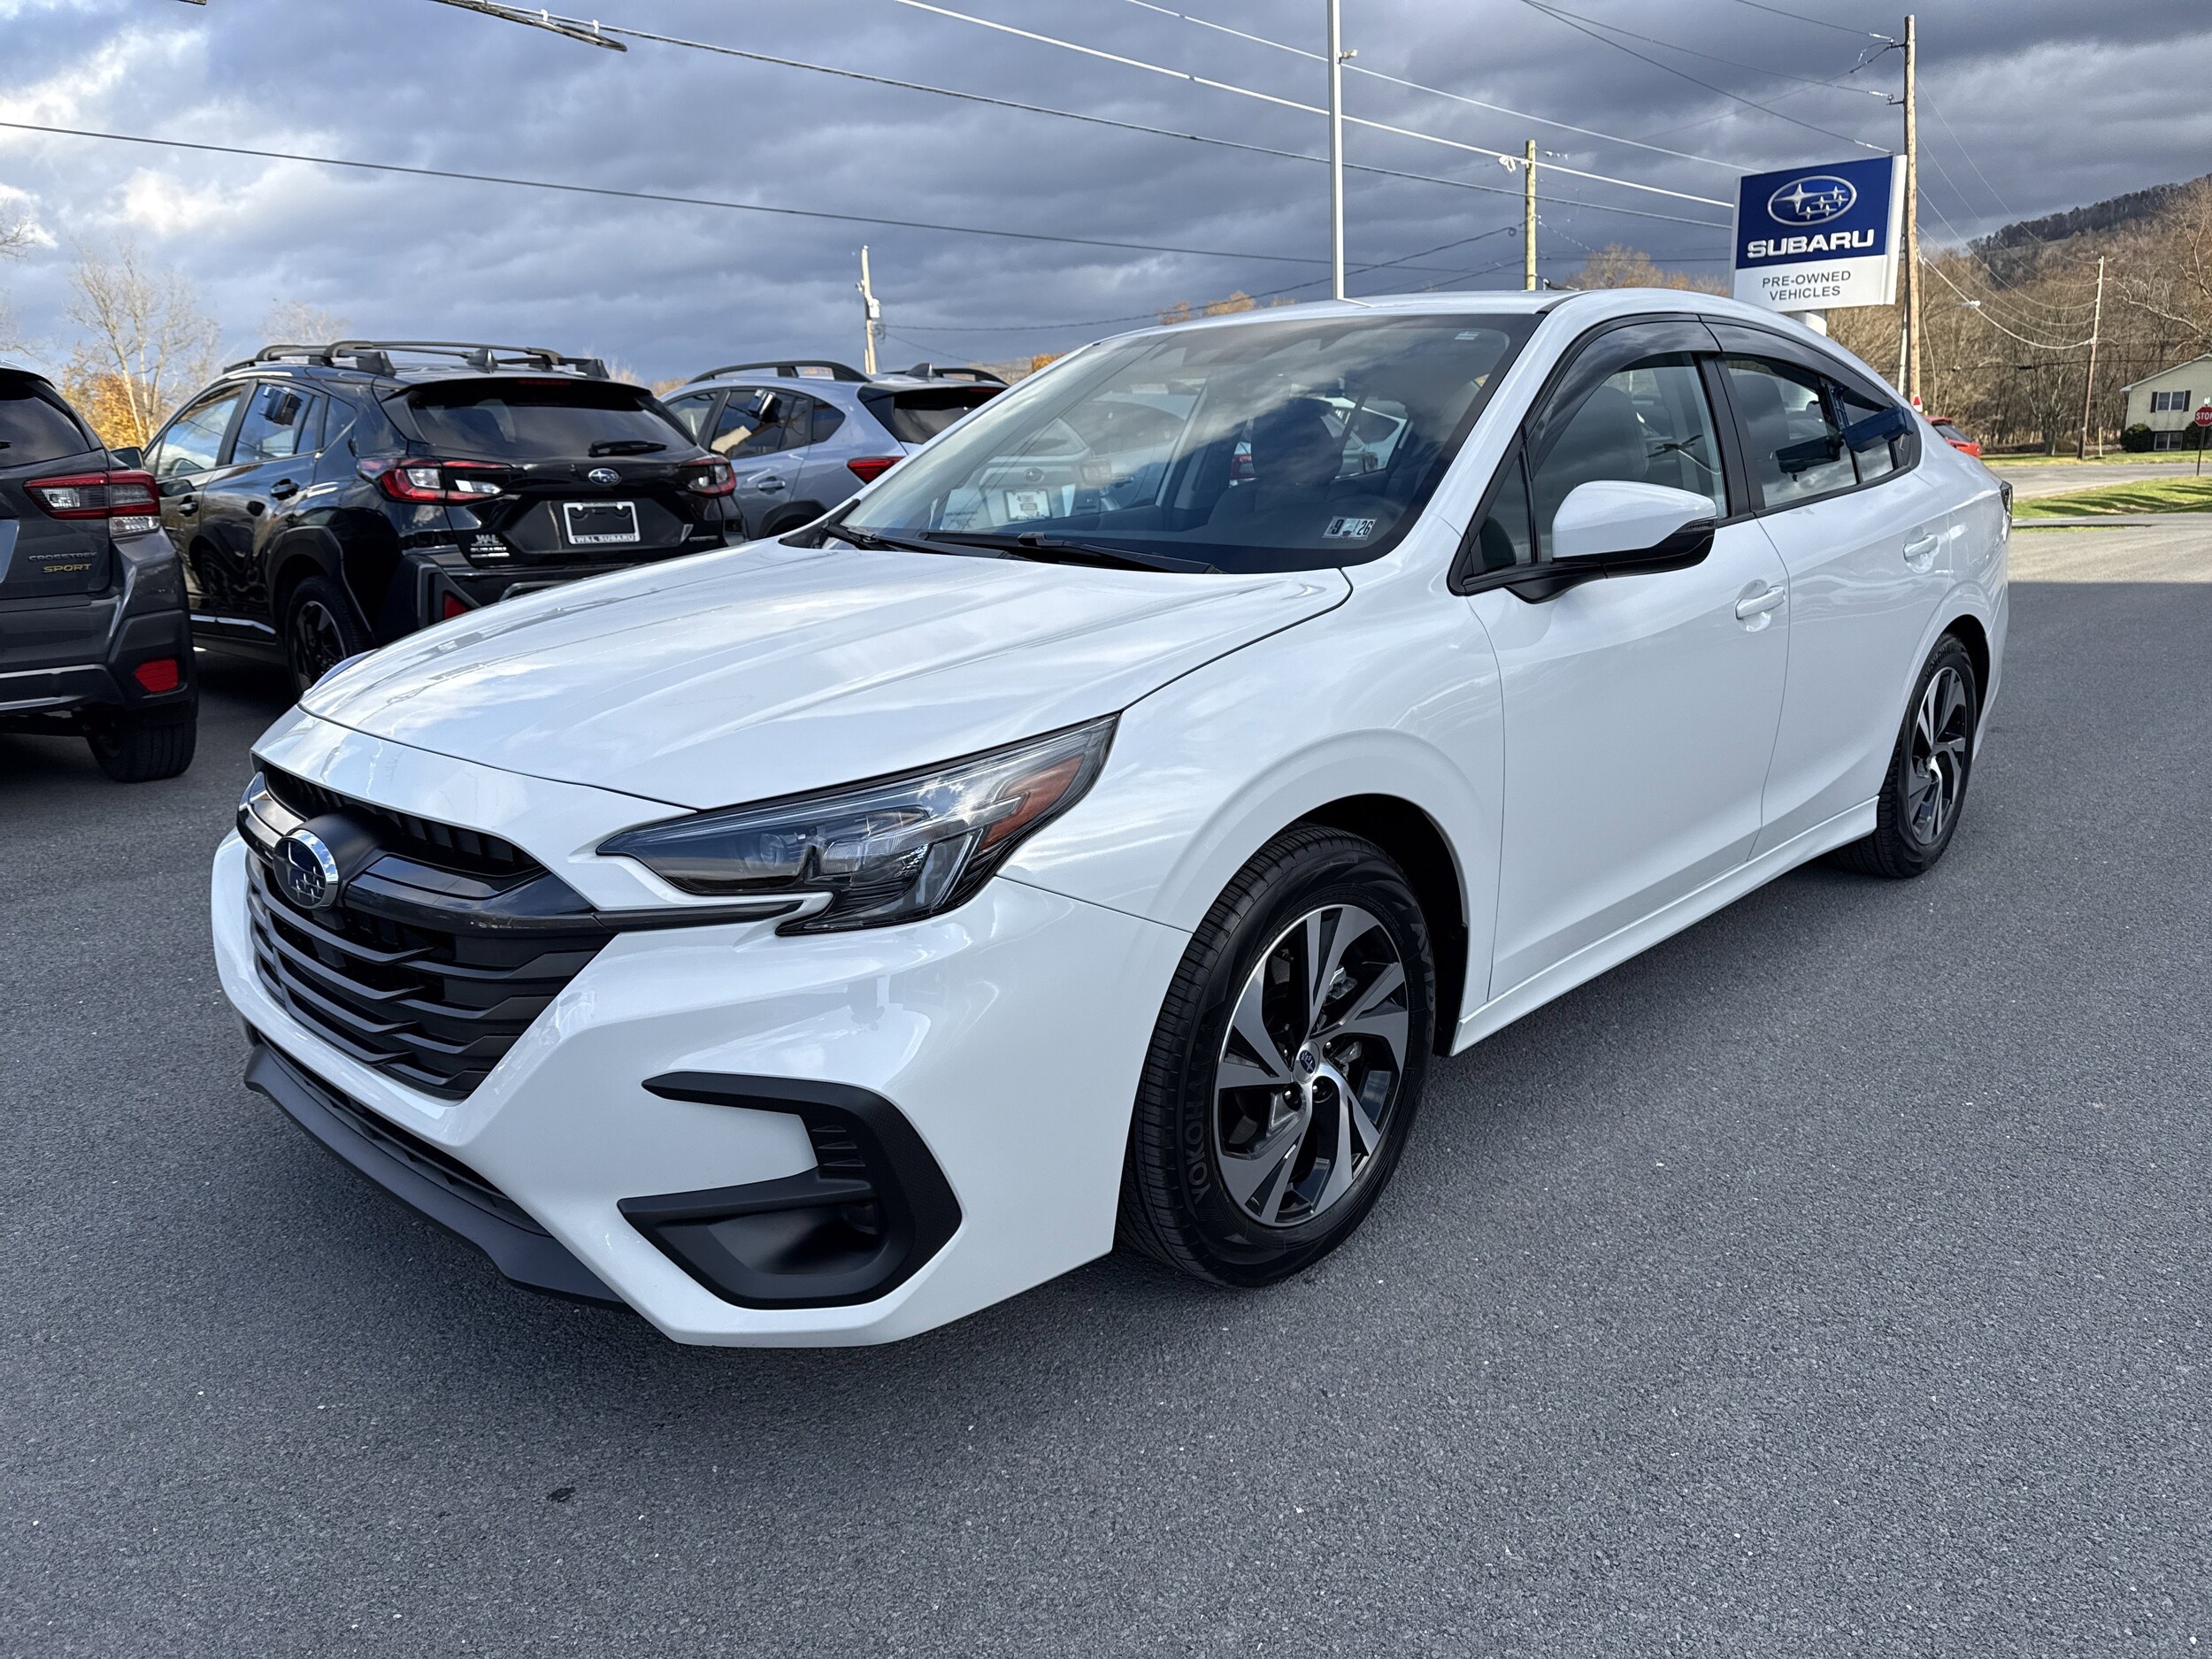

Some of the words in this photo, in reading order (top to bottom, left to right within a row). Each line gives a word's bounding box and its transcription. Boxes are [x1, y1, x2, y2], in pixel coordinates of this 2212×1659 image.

[1747, 229, 1875, 259] SUBARU
[1762, 270, 1851, 288] PRE-OWNED
[1770, 286, 1840, 302] VEHICLES
[1332, 518, 1345, 534] 9
[1356, 520, 1373, 535] 26
[29, 551, 97, 562] CROSSTREK
[43, 563, 92, 574] SPORT
